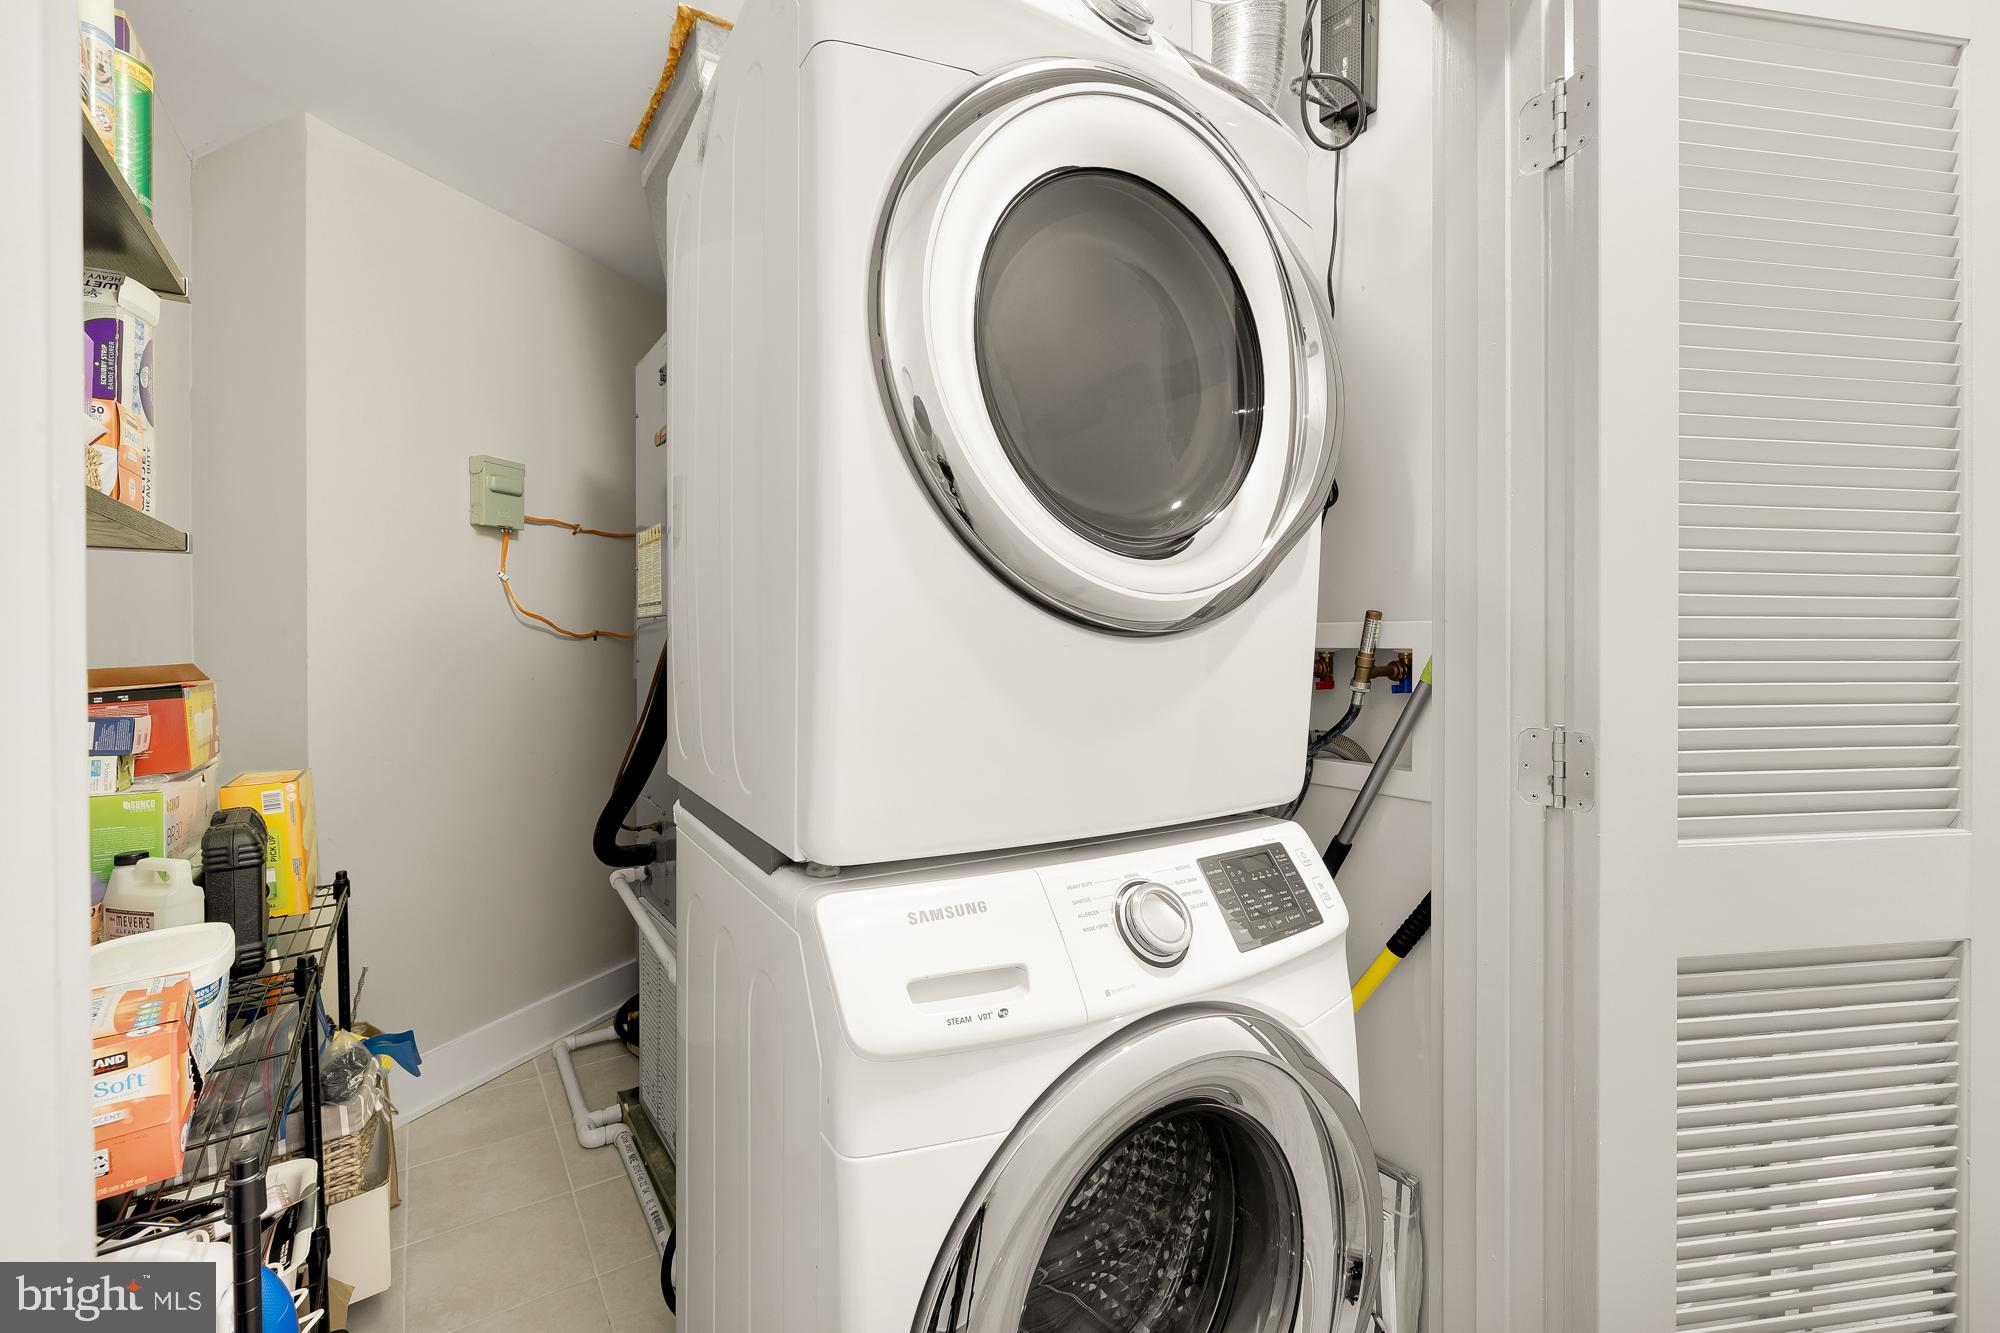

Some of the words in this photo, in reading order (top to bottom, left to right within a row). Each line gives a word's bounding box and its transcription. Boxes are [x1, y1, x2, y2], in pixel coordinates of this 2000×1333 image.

[268, 835, 275, 846] UP
[907, 900, 987, 926] SAMSUNG
[115, 915, 150, 929] MEYER'S
[946, 1015, 972, 1026] STEAM
[94, 1073, 145, 1098] Soft
